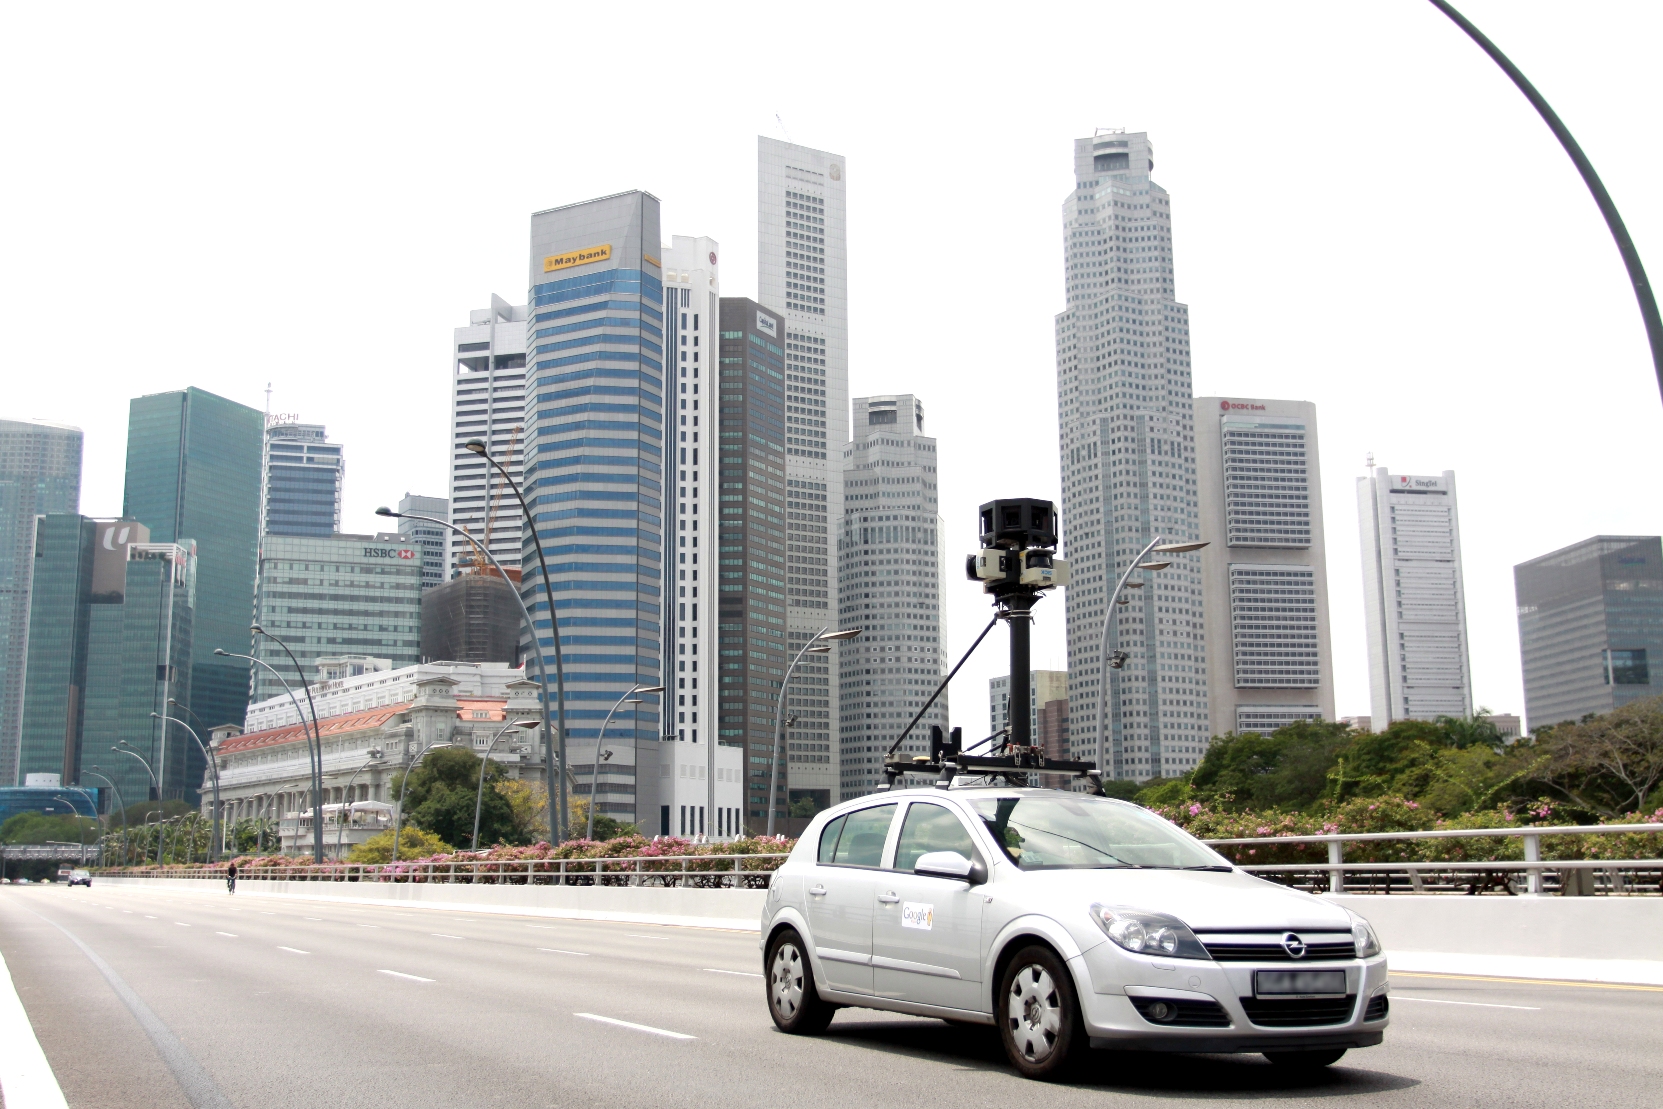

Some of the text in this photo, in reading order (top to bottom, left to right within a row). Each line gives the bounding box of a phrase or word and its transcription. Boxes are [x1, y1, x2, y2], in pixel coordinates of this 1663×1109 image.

[554, 249, 608, 265] Maybank
[1415, 479, 1437, 488] SingTel
[363, 547, 397, 558] HSBC
[903, 906, 927, 925] Google
